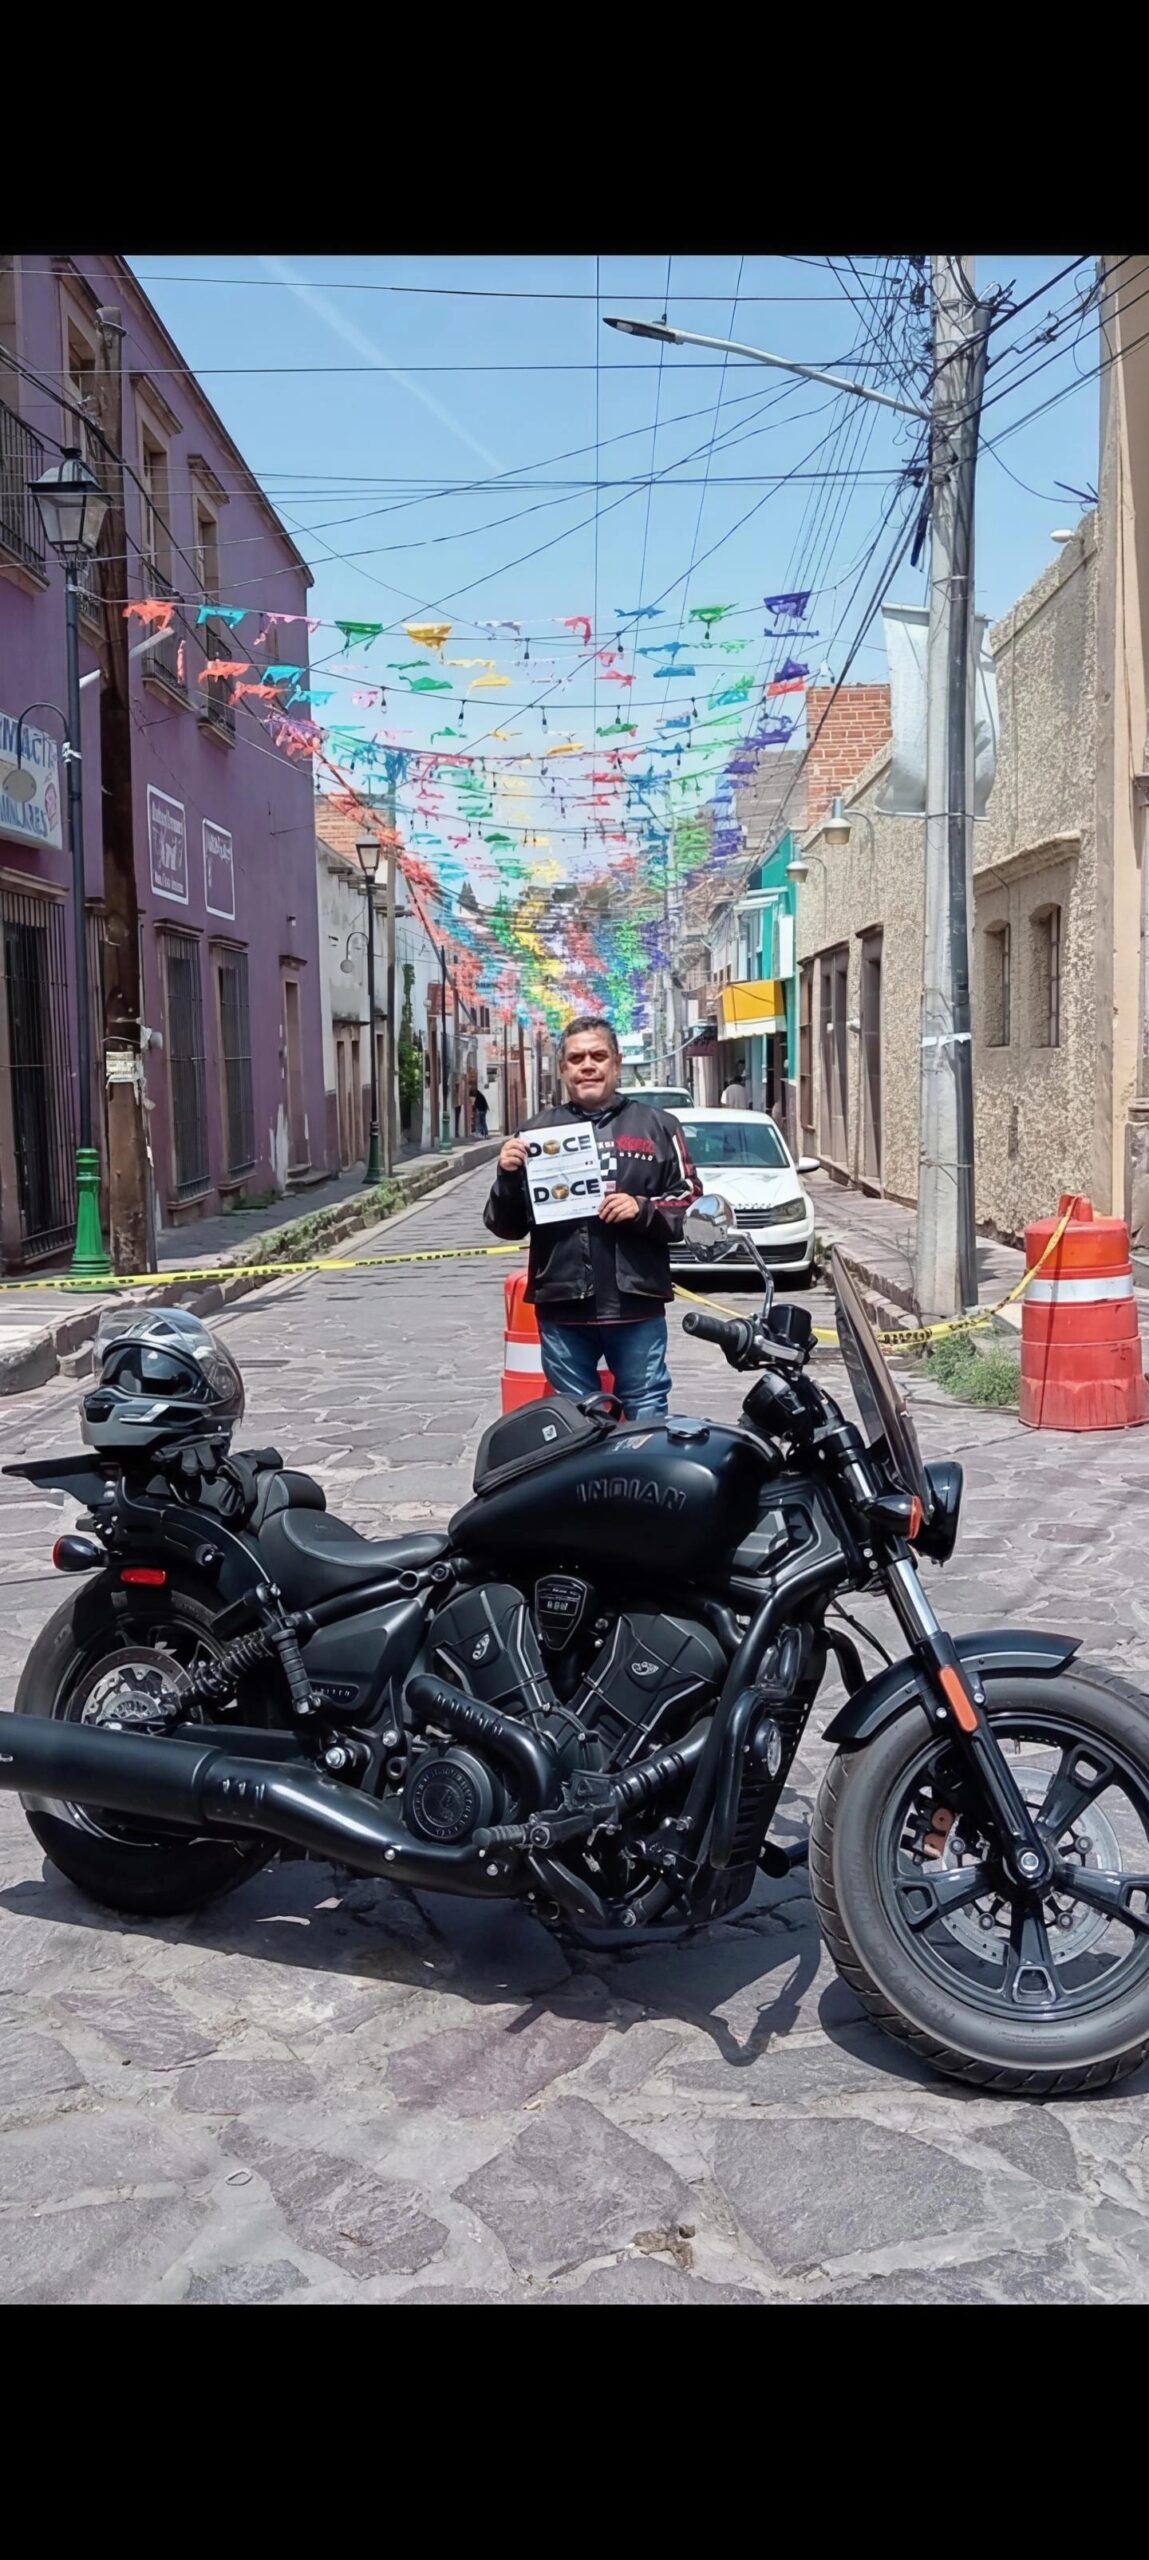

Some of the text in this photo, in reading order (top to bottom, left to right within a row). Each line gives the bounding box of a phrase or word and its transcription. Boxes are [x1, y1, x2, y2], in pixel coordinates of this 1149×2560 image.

[527, 1134, 592, 1158] DOCE
[533, 1178, 601, 1203] DOCE
[576, 1478, 687, 1511] INDIAN
